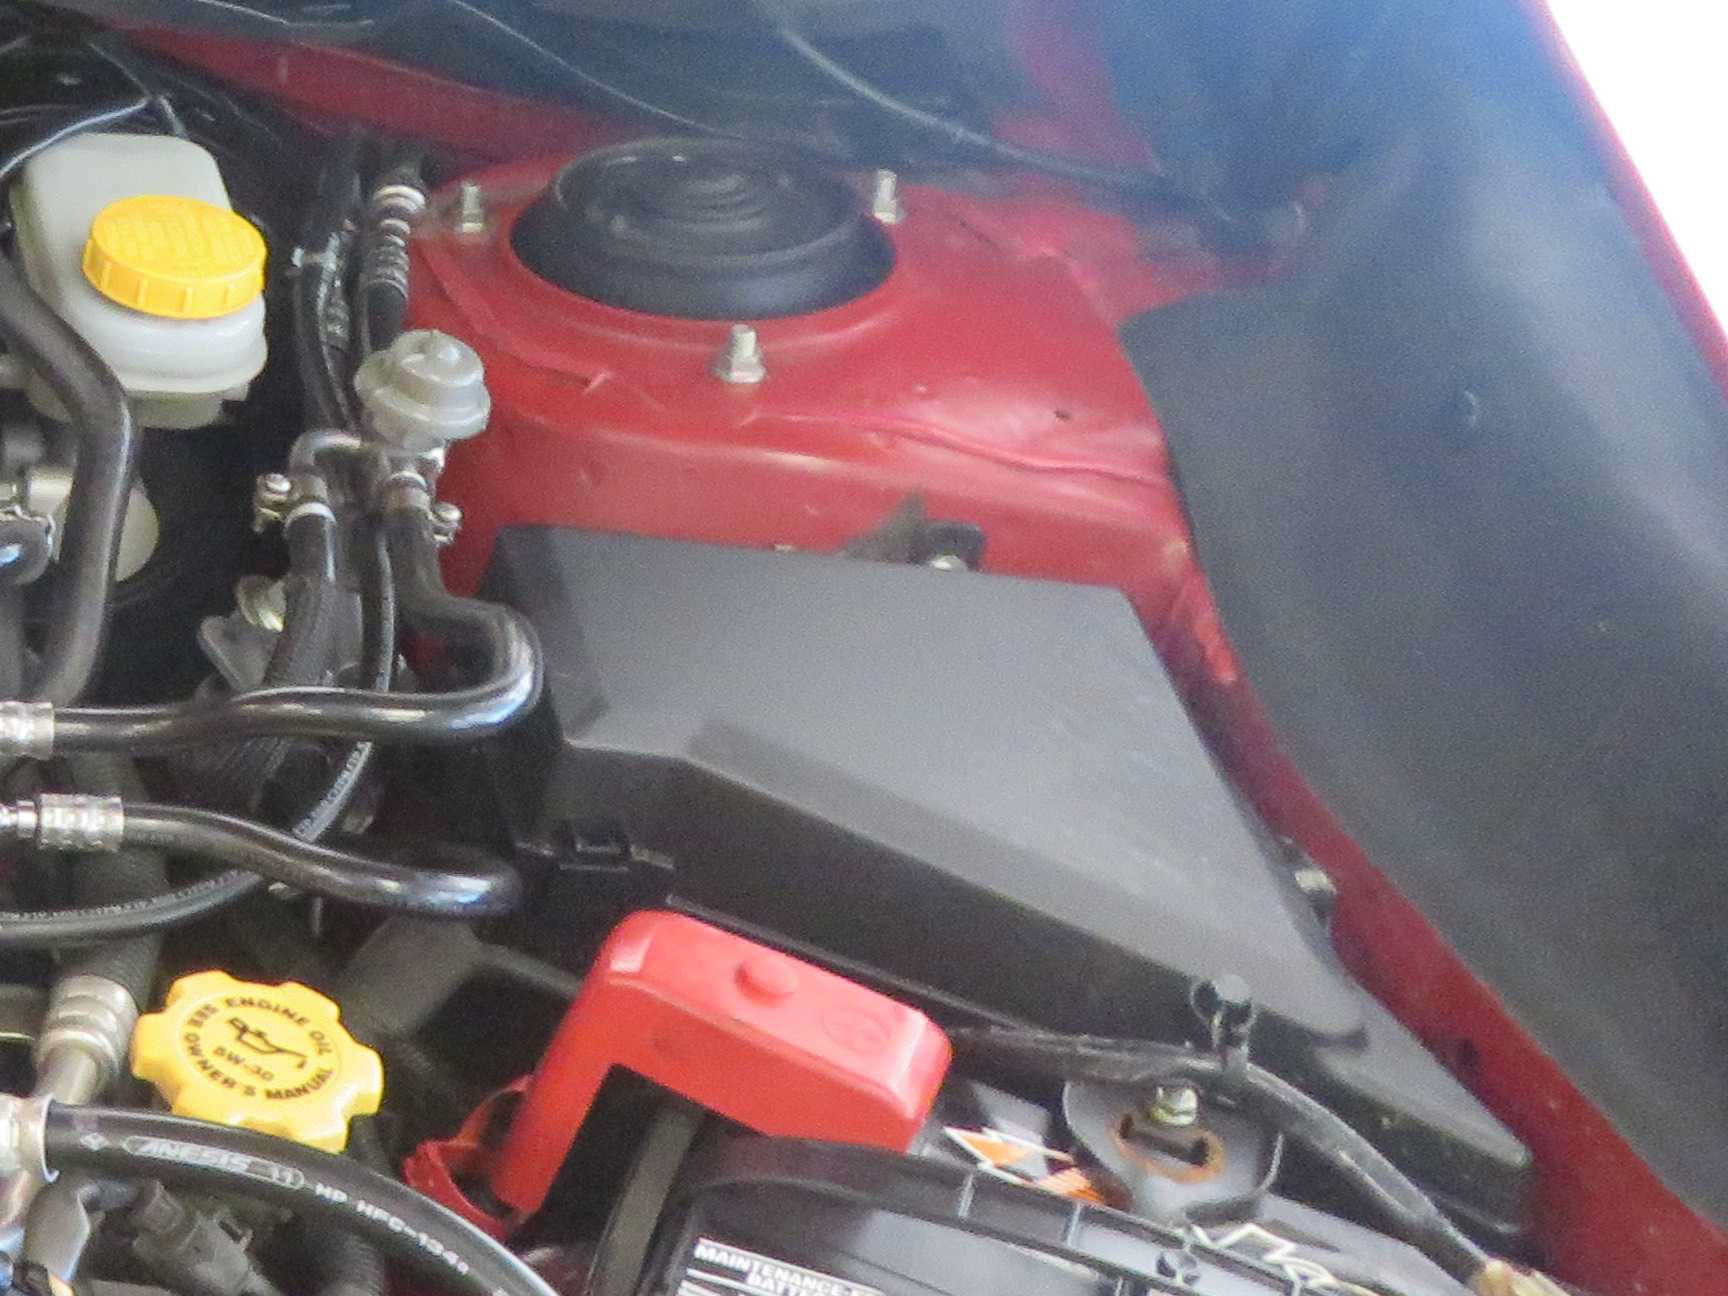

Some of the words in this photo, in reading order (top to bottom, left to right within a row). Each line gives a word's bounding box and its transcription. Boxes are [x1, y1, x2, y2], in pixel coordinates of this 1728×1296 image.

[187, 1003, 219, 1028] SEE
[263, 1067, 335, 1100] MANUAL
[224, 996, 311, 1026] ENGINE
[308, 1029, 333, 1057] OIL
[212, 1045, 276, 1082] 5W-30
